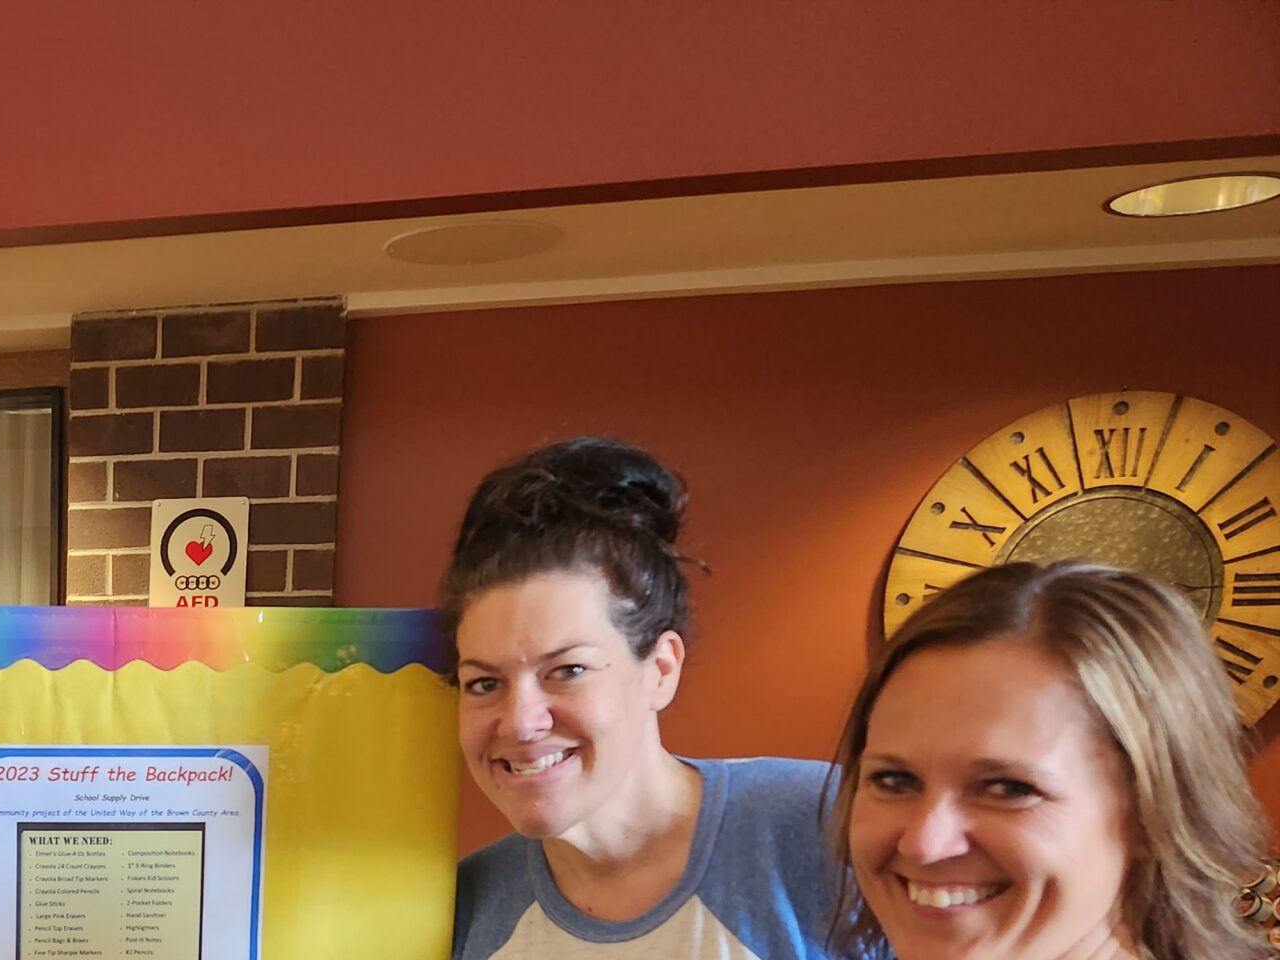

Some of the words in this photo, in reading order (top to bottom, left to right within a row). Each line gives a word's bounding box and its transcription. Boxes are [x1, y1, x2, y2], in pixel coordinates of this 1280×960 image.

[1093, 427, 1147, 480] XII
[48, 766, 100, 783] Stuff
[108, 766, 136, 782] the
[146, 766, 234, 787] Backpack!
[74, 794, 99, 802] School
[102, 794, 127, 803] Supply
[32, 809, 60, 818] project
[63, 809, 72, 817] of
[75, 809, 87, 817] the
[90, 809, 116, 817] United
[120, 809, 135, 818] Way
[138, 809, 147, 817] of
[152, 809, 163, 817] the
[167, 809, 189, 817] Brown
[192, 809, 217, 818] County
[29, 836, 60, 846] WHAT
[63, 836, 79, 846] WE
[82, 836, 113, 846] NEED:
